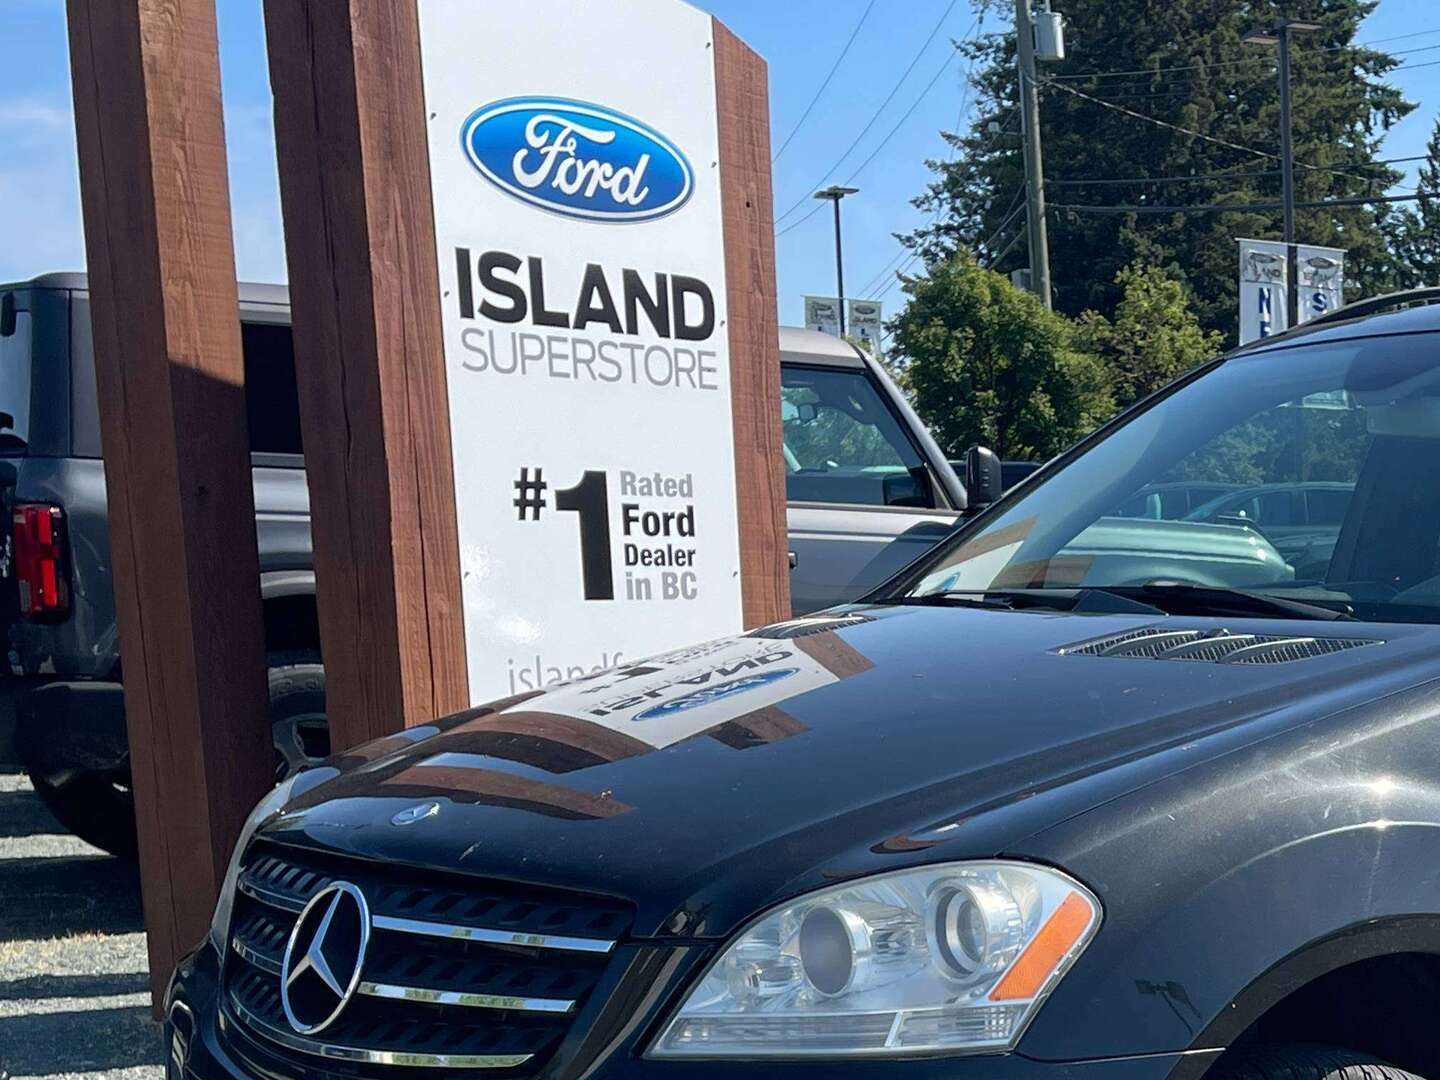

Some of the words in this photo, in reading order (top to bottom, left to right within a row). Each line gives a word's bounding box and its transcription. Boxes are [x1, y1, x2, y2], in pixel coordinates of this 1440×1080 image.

[512, 113, 650, 206] Ford
[455, 246, 716, 341] ISLAND
[460, 327, 719, 391] SUPERSTORE
[620, 470, 694, 498] Rated
[622, 503, 696, 537] Ford
[624, 543, 696, 567] Dealer
[625, 571, 652, 601] in
[661, 571, 698, 601] BC
